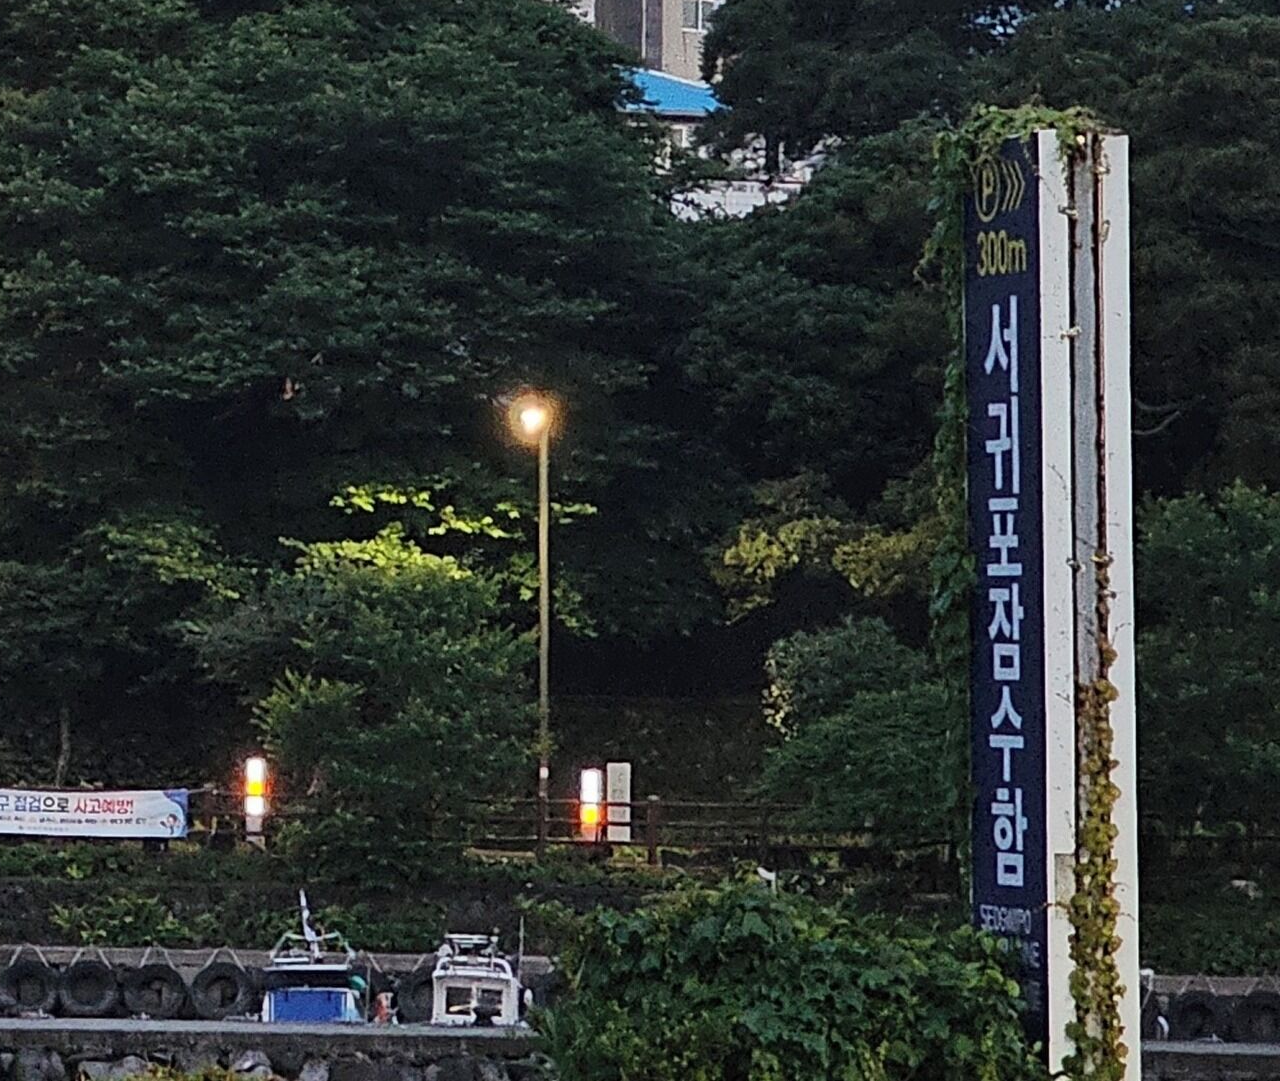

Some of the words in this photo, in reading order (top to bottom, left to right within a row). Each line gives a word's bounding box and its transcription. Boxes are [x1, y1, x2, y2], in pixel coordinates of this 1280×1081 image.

[977, 229, 1027, 277] 300m
[983, 294, 1029, 888] 서귀포잠수함
[14, 794, 70, 814] 점검으로
